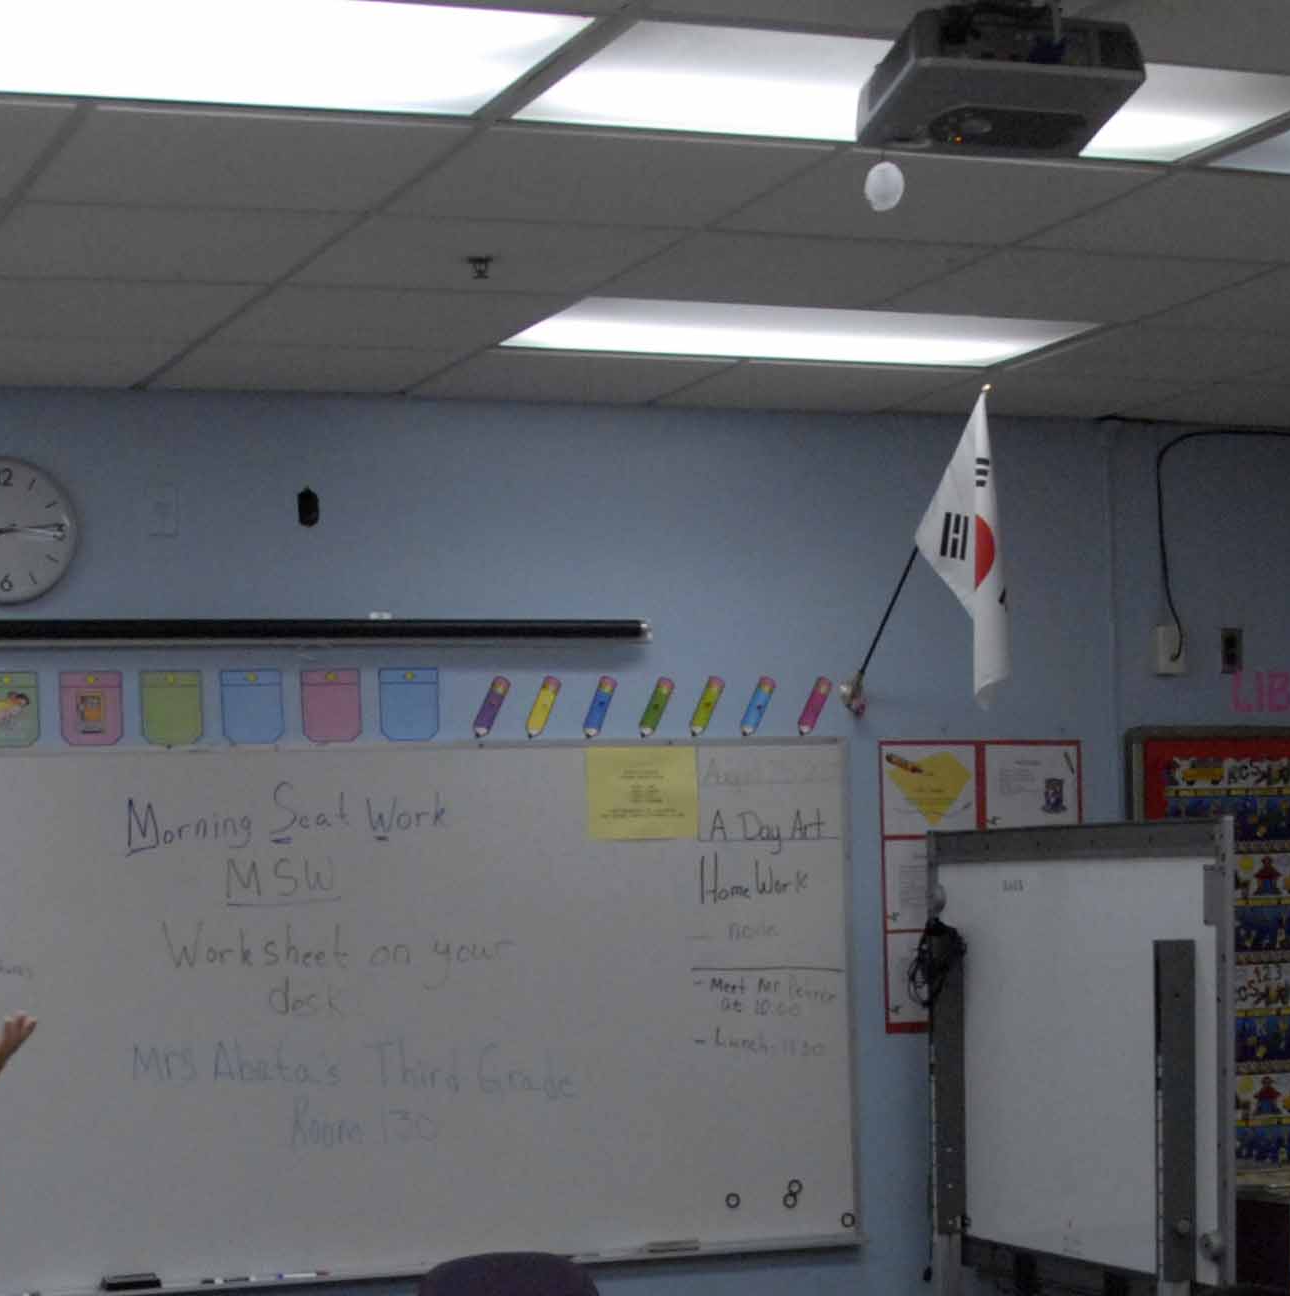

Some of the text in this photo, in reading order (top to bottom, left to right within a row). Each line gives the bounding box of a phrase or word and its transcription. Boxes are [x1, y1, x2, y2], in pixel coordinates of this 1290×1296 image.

[0, 574, 13, 592] 6
[125, 780, 448, 850] Morning Seat Work
[709, 808, 727, 841] A
[737, 809, 783, 855] Day
[159, 918, 517, 992] Worksheet on your
[367, 1038, 462, 1094] Third
[475, 1042, 583, 1102] Grade
